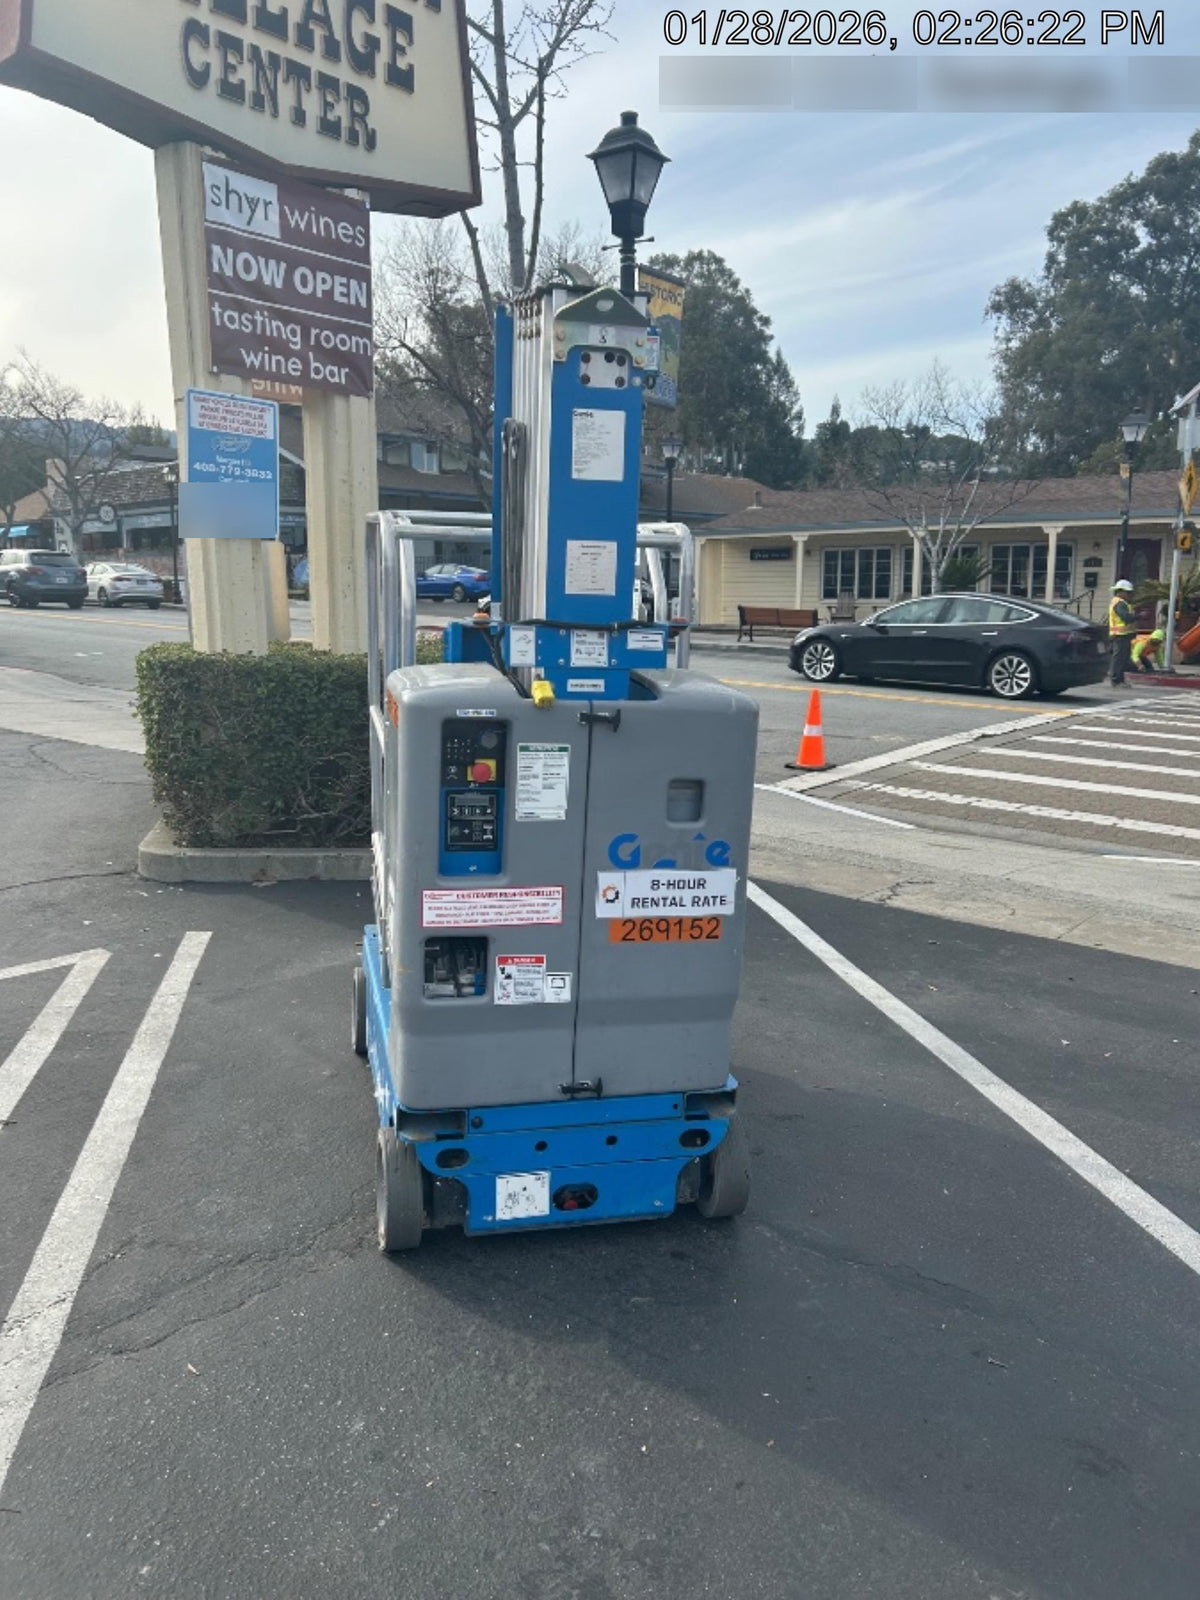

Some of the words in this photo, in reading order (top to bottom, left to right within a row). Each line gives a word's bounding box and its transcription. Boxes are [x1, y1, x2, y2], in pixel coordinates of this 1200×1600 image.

[186, 0, 415, 94] LAGE
[181, 17, 377, 153] CENTER
[210, 176, 273, 226] shyr
[284, 206, 365, 247] wines
[211, 244, 287, 289] NOW
[293, 266, 368, 308] OPEN
[211, 302, 302, 350] tasting
[310, 327, 371, 356] room
[240, 346, 303, 376] wine
[309, 352, 349, 385] bar
[631, 896, 687, 909] RENTAL
[691, 895, 728, 908] RATE
[650, 878, 707, 891] 8-HOUR
[621, 917, 721, 942] 269152
